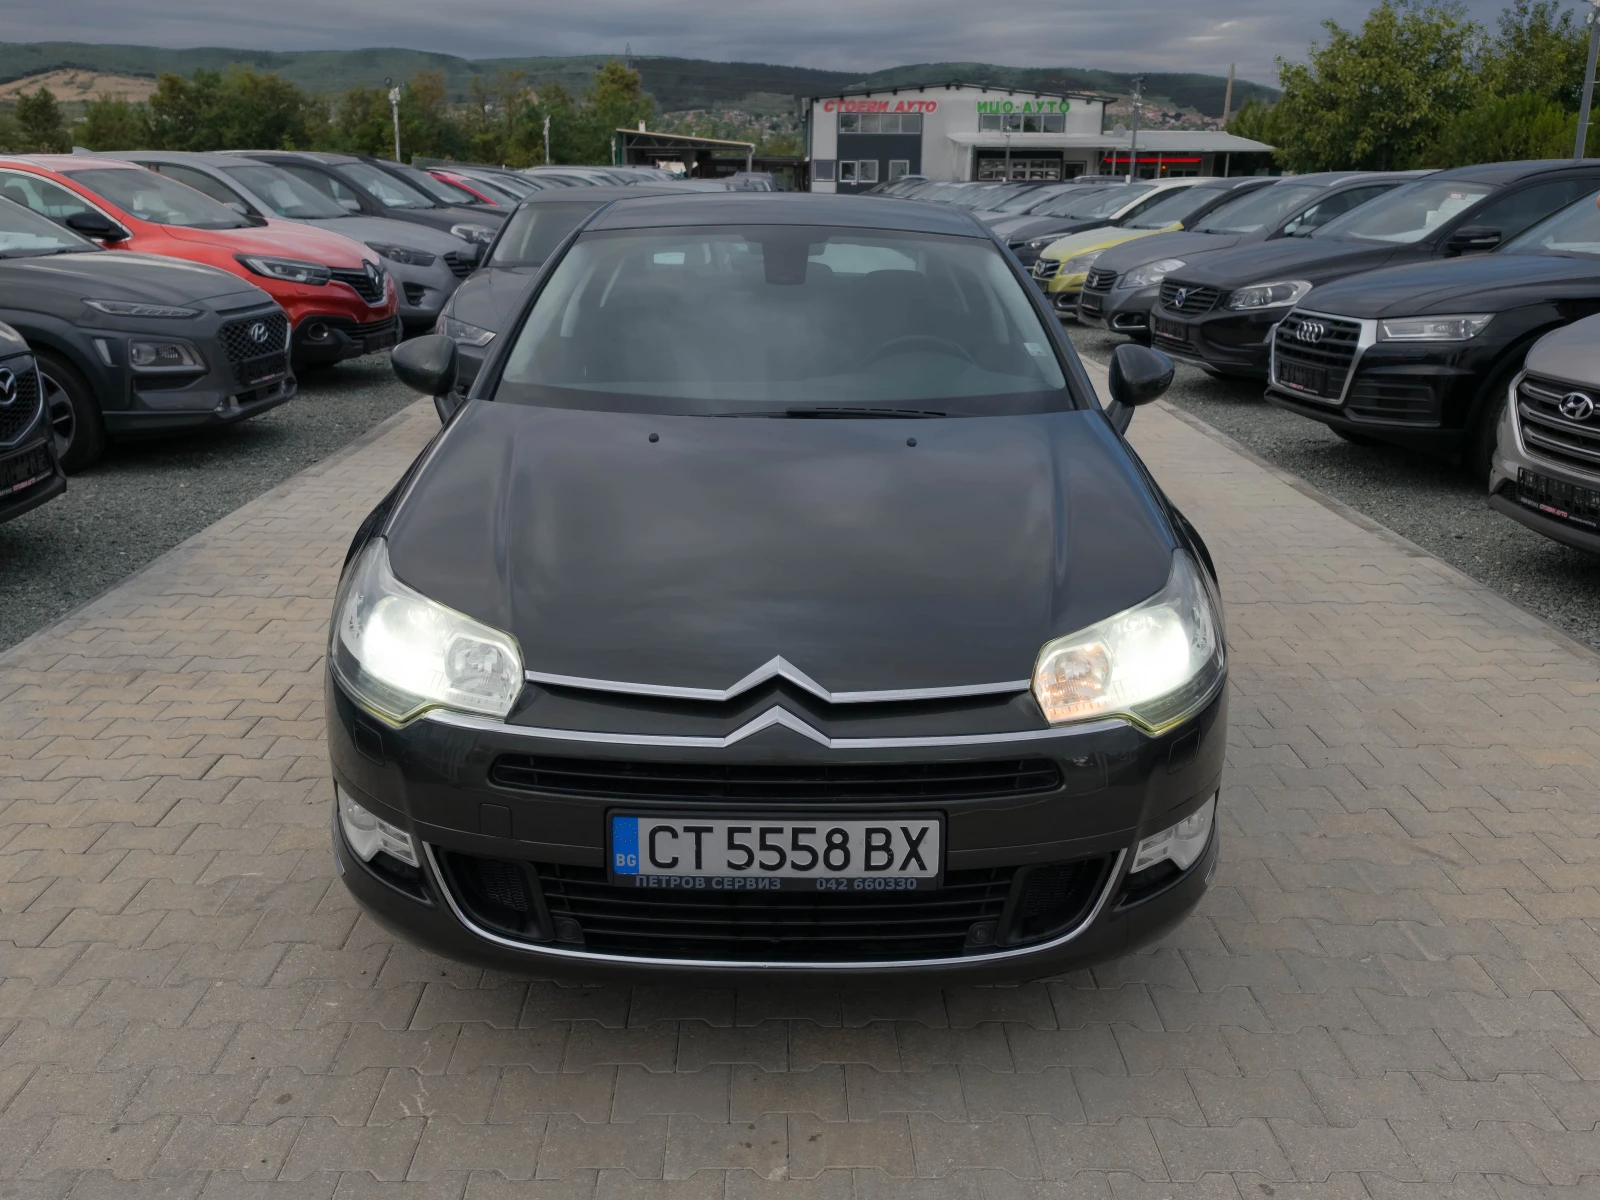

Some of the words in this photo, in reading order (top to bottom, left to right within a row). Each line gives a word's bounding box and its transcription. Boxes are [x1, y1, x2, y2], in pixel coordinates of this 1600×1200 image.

[824, 100, 889, 113] СТОЕВИ
[894, 101, 938, 113] АУТО
[977, 101, 1070, 114] ИЦО-АУТО
[649, 825, 714, 870] CT
[726, 826, 851, 871] 5558
[864, 826, 930, 871] BX
[616, 853, 637, 867] BG
[635, 875, 706, 889] ПЕТРОВ
[711, 876, 781, 890] СЕРВИЗ
[816, 878, 848, 890] 042
[853, 878, 917, 890] 660330
